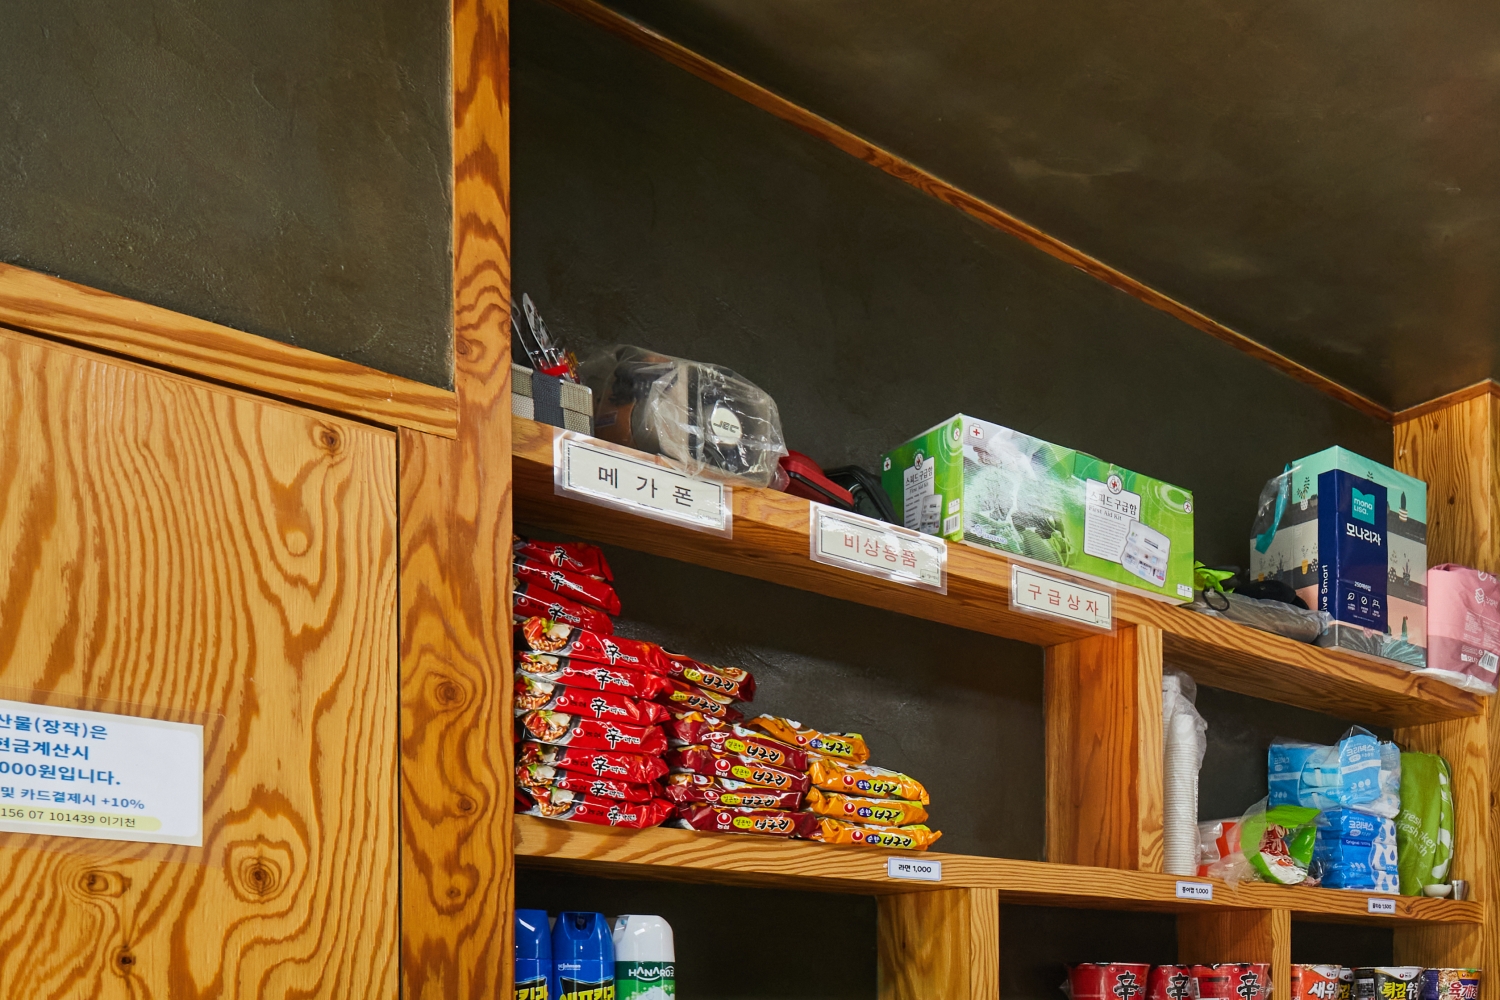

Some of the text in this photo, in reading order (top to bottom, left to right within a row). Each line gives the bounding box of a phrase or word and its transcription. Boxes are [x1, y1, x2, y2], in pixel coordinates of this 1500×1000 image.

[1088, 505, 1122, 520] First Aid Kit
[1354, 498, 1373, 510] mona
[1346, 523, 1381, 546] 모나리자
[844, 533, 918, 568] 비상용품
[1, 786, 145, 810] 및 카드결제시 +10%
[0, 808, 136, 828] 156 07 101439 이기천
[1349, 821, 1374, 831] 크리넥스
[913, 865, 931, 874] 1,000
